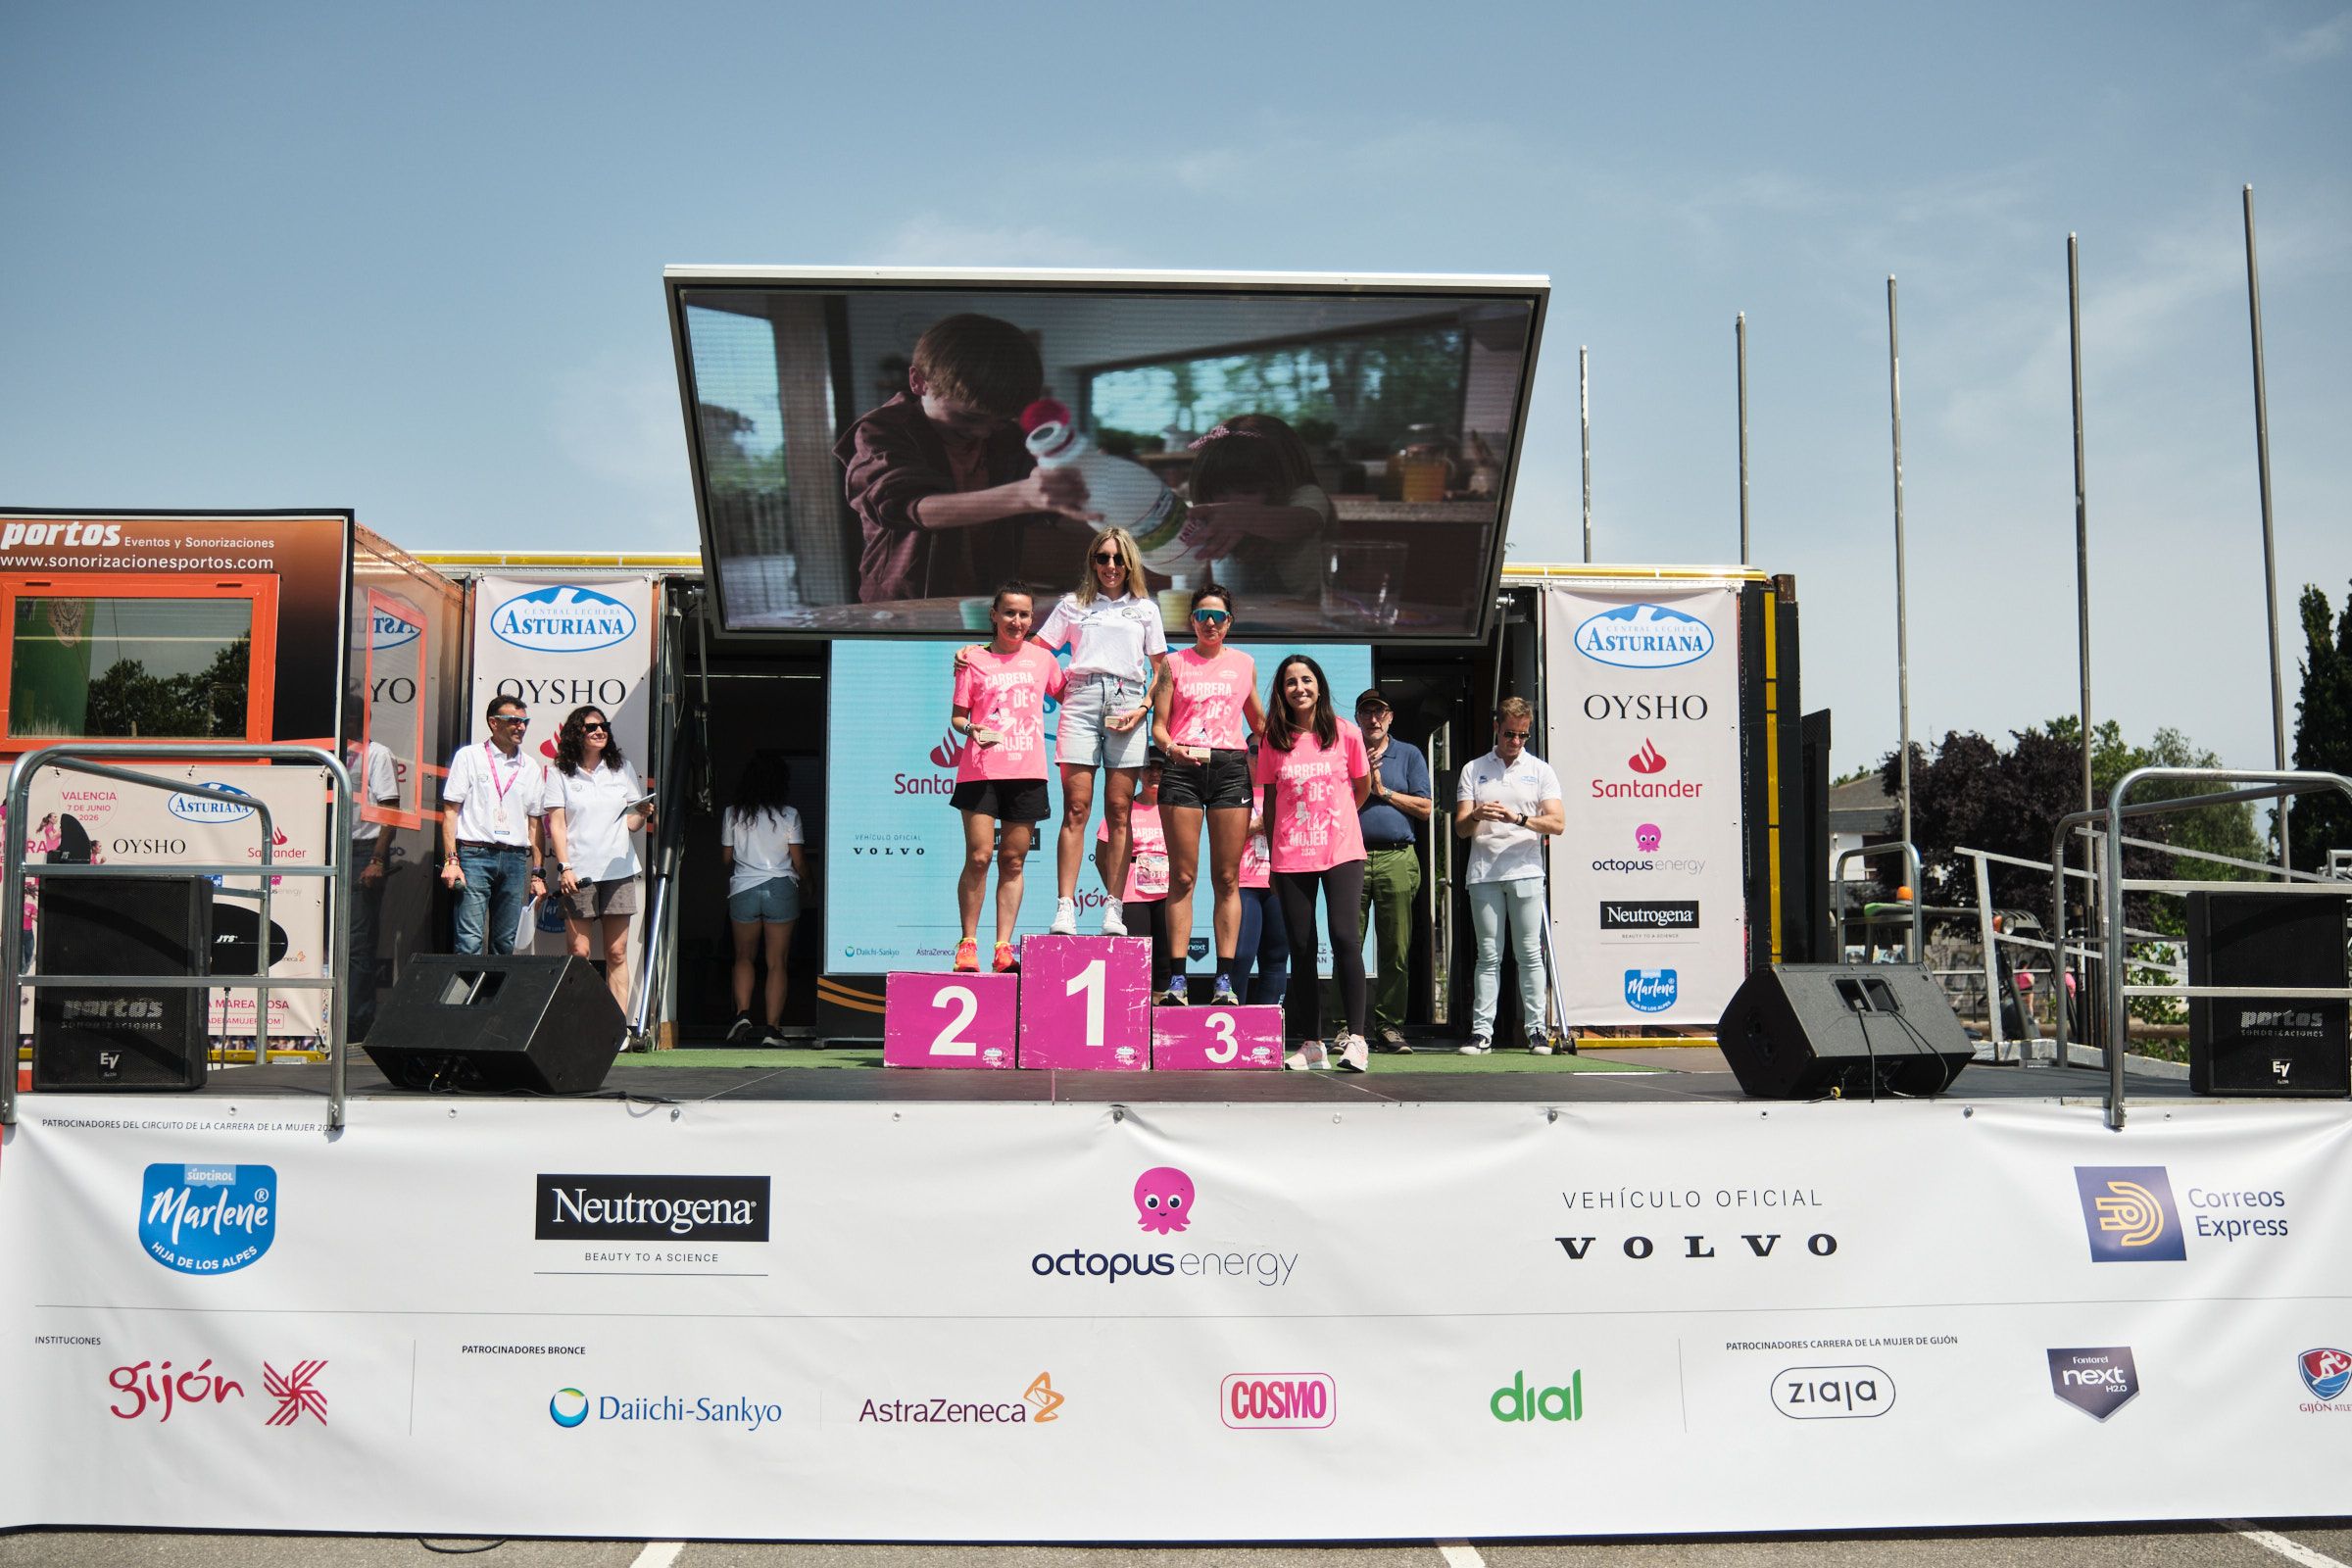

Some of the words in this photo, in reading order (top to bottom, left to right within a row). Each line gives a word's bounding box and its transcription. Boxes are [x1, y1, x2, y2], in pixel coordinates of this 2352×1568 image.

[1, 521, 122, 550] portos
[124, 536, 171, 547] Eventos
[174, 539, 182, 549] y
[185, 537, 275, 549] Sonorizaciones
[0, 554, 274, 570] www.sonorizacionesportos.com
[501, 610, 625, 635] ASTURIANA
[1586, 627, 1704, 652] ASTURIANA
[497, 678, 626, 705] OYSHO
[984, 671, 1035, 690] CARRERA
[1182, 681, 1233, 699] CARRERA
[1584, 694, 1708, 720] OYSHO
[1281, 761, 1333, 781] CARRERA
[62, 792, 117, 801] VALENCIA
[1308, 781, 1326, 803] DE
[1592, 779, 1703, 798] Santander
[113, 839, 186, 855] OYSHO
[1289, 829, 1329, 848] MUJER
[248, 847, 307, 858] Saander
[1592, 858, 1653, 874] octopus
[1655, 858, 1706, 875] energy
[1607, 906, 1693, 926] Neutrogena
[916, 948, 956, 956] AstraZeneca
[1627, 978, 1676, 1002] Marlene
[268, 1000, 289, 1009] OSA
[1066, 959, 1106, 1047] 1
[929, 986, 978, 1056] 2
[1204, 1011, 1240, 1064] 3
[42, 1119, 121, 1128] PATROCINADORES
[122, 1120, 139, 1129] DEL
[185, 1121, 198, 1130] DE
[200, 1121, 212, 1130] LA
[214, 1122, 254, 1131] CARRERA
[1562, 1187, 1701, 1209] VEHÍCULO
[1715, 1189, 1824, 1207] OFICIAL
[2187, 1188, 2285, 1208] Correos
[148, 1187, 270, 1246] Marlene
[552, 1188, 758, 1234] Neutrogena
[2195, 1215, 2288, 1243] Express
[151, 1242, 175, 1263] HIJA
[176, 1256, 194, 1269] DE
[195, 1258, 220, 1270] LOS
[221, 1246, 259, 1269] ALPES
[585, 1252, 631, 1261] BEAUTY
[636, 1253, 651, 1262] TO
[666, 1253, 719, 1262] SCIENCE
[1554, 1233, 1838, 1259] VOLVO
[1031, 1249, 1175, 1284] octopus
[1180, 1252, 1298, 1286] energy
[34, 1336, 102, 1346] INSTITUCIONES
[462, 1346, 546, 1354] PATROCINADORES
[1726, 1341, 1808, 1350] PATROCINADORES
[1810, 1339, 1852, 1348] CARRERA
[1854, 1339, 1868, 1348] DE
[1884, 1337, 1914, 1347] MUJER
[1916, 1337, 1929, 1346] DE
[1931, 1334, 1959, 1346] GIJÓN
[2062, 1366, 2126, 1386] next
[109, 1358, 245, 1423] gijón
[1231, 1380, 1327, 1419] COSMO
[1490, 1368, 1583, 1422] dial
[599, 1396, 782, 1431] Daiichi-Sankyo
[859, 1398, 1026, 1423] AstraZeneca
